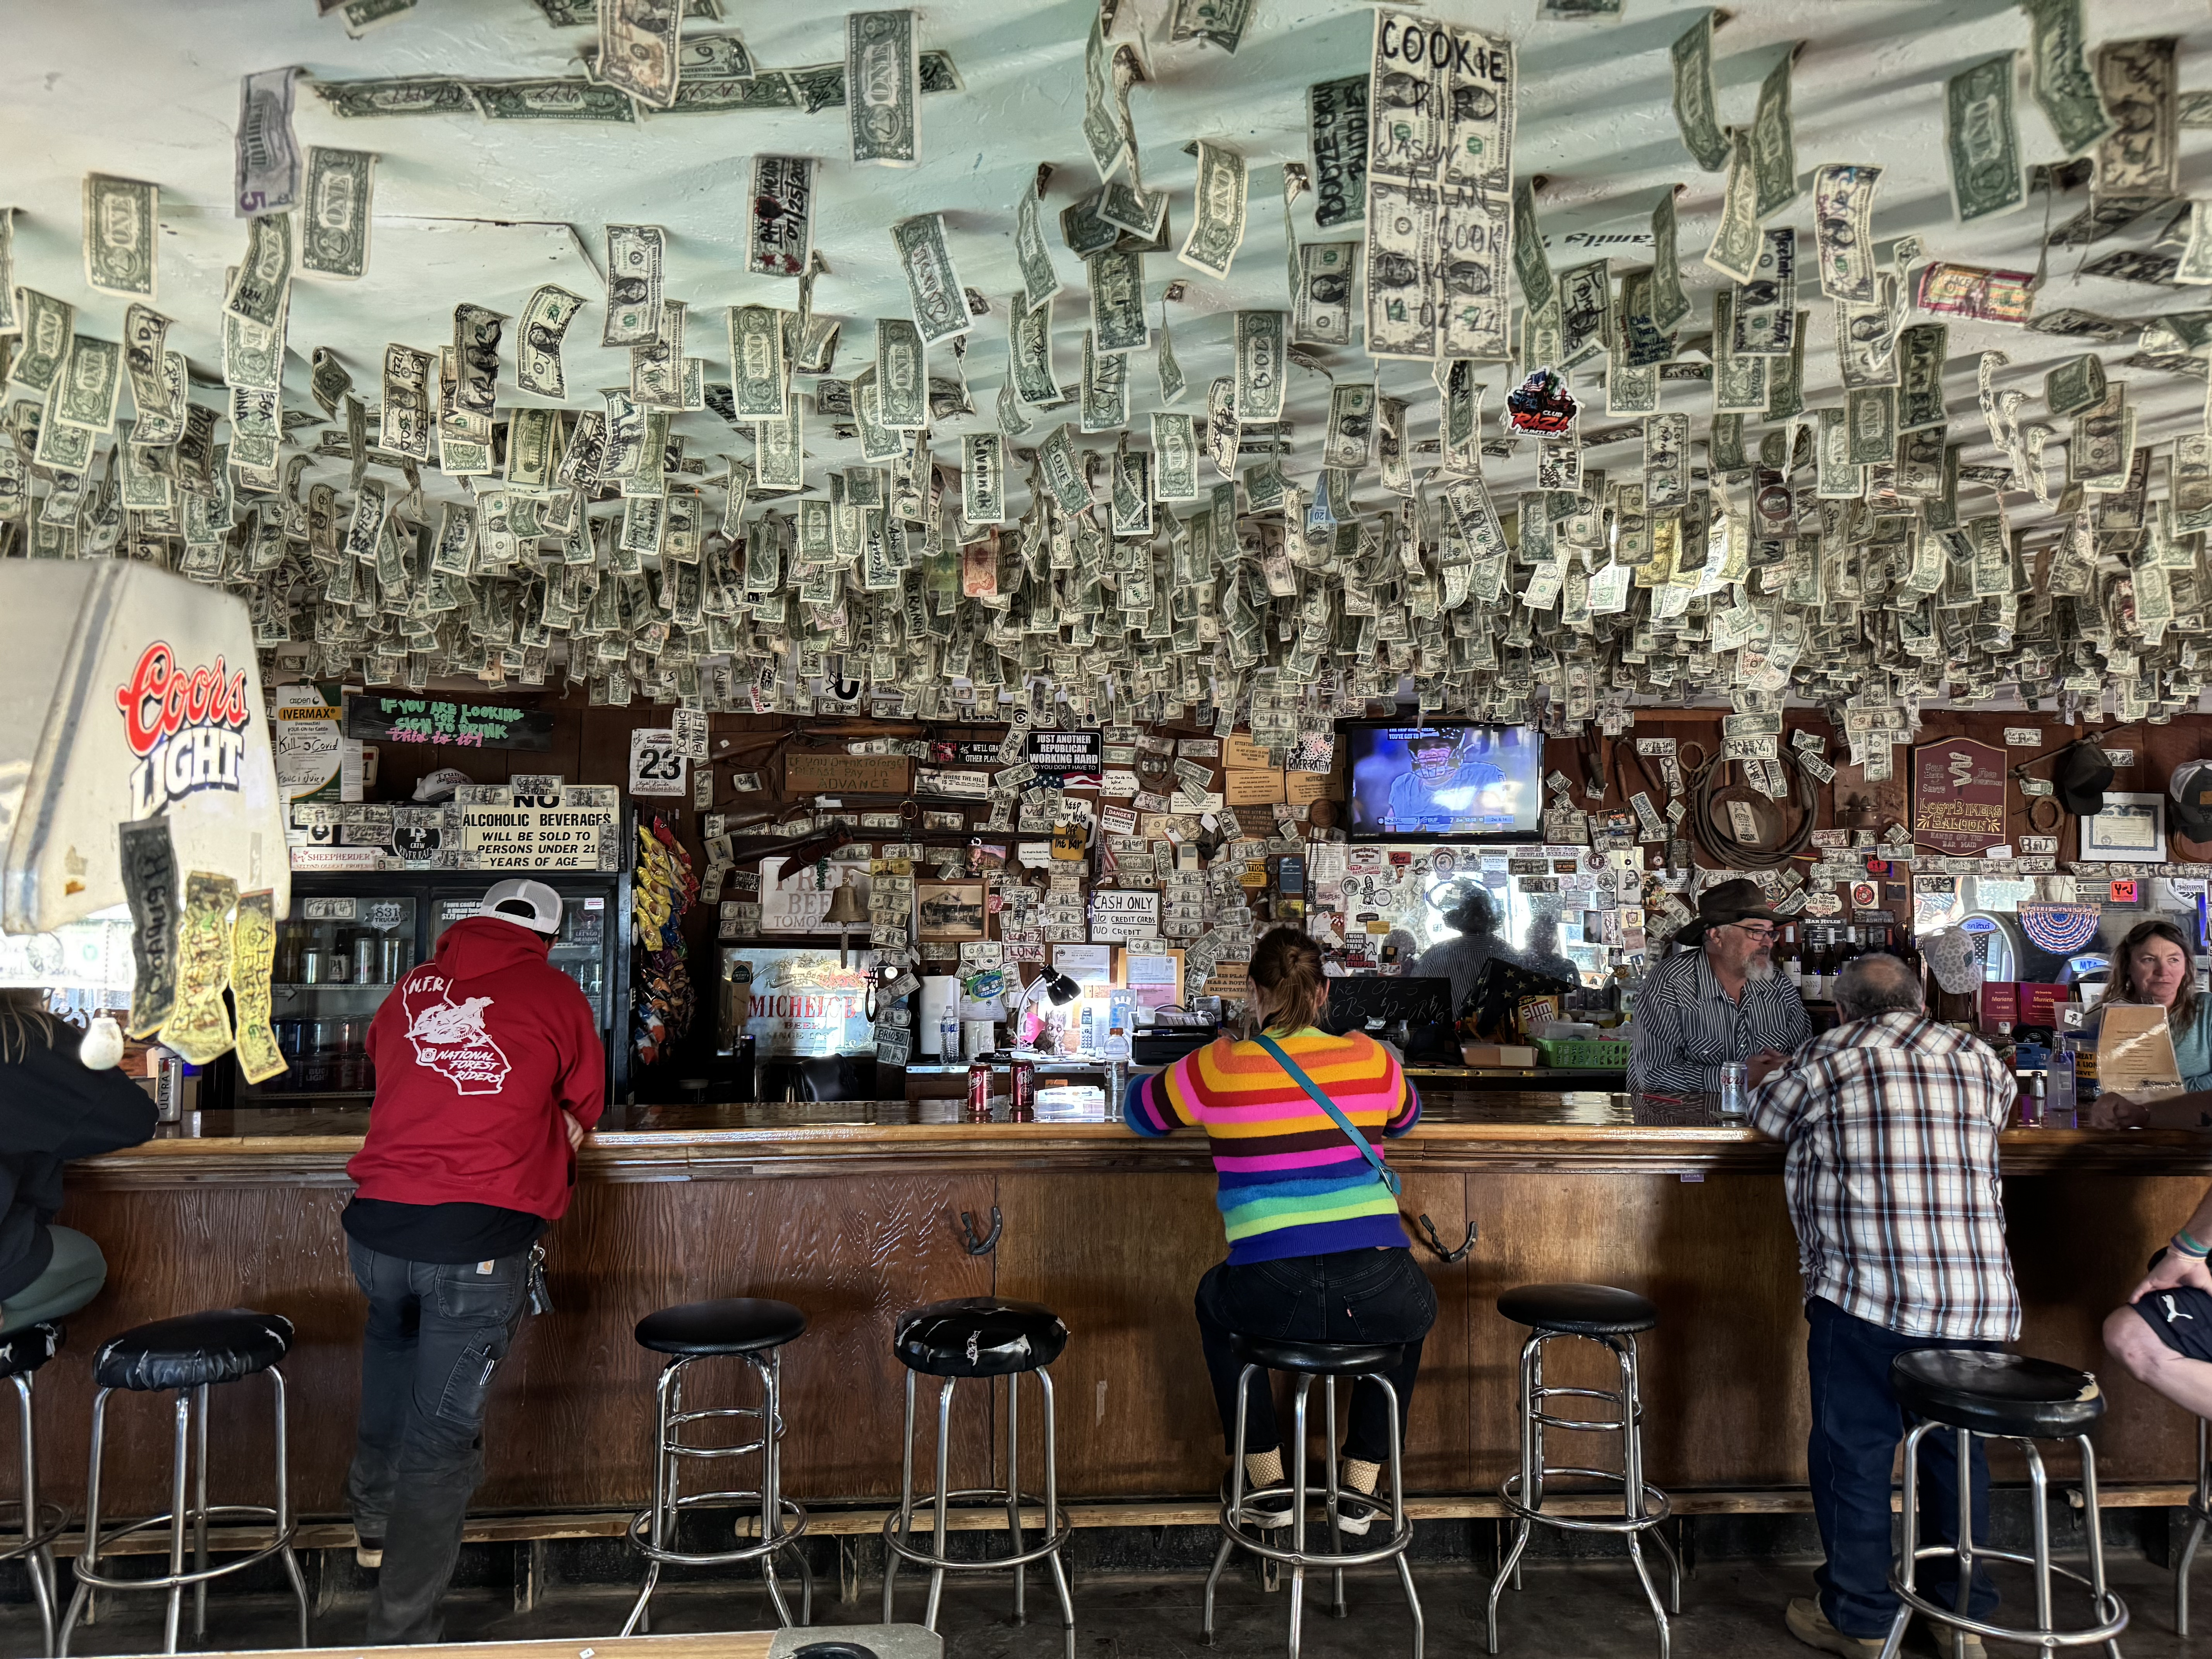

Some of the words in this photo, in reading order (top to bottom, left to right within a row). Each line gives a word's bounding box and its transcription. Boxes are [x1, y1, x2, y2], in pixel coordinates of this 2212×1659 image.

[1381, 20, 1507, 83] COOKIE
[1378, 121, 1458, 164] JASON
[323, 172, 351, 228] ONE
[1438, 216, 1500, 254] COOK
[747, 333, 765, 378] ONE
[894, 348, 912, 387] ONE
[1510, 409, 1571, 431] RAZA
[1519, 427, 1558, 437] HUMILDE
[1045, 440, 1078, 496] BONER
[115, 640, 250, 757] Coors
[381, 698, 397, 714] IF
[397, 699, 426, 714] YOU
[430, 702, 457, 715] ARE
[462, 704, 524, 722] LOOKING
[434, 714, 456, 723] FOR
[460, 715, 470, 725] A
[395, 717, 433, 734] SIGN
[435, 722, 455, 733] TO
[458, 723, 509, 739] DRINK
[312, 738, 338, 751] Covid
[1037, 735, 1056, 744] JUST
[1056, 735, 1091, 744] ANOTHER
[1041, 744, 1087, 753] REPUBLICAN
[639, 749, 681, 780] 23
[787, 757, 800, 766] IF
[805, 758, 827, 766] YOU
[1029, 754, 1073, 763] WORKING
[1073, 754, 1098, 764] HARD
[130, 726, 245, 821] LIGHT
[817, 779, 889, 789] ADVANCE
[514, 795, 560, 808] NO
[463, 813, 529, 826] ALCOHOLIC
[539, 813, 611, 826] BEVERAGES
[1108, 809, 1133, 819] DANGER
[1111, 818, 1133, 826] SMOKING
[483, 832, 512, 841] WILL
[518, 832, 534, 841] BE
[539, 832, 571, 841] SOLD
[575, 831, 591, 841] TO
[1930, 832, 1953, 840] HANDS
[477, 845, 537, 854] PERSONS
[538, 845, 578, 854] UNDER
[583, 844, 596, 853] 21
[489, 857, 529, 867] YEARS
[534, 857, 550, 866] OF
[555, 857, 579, 866] AGE
[2114, 884, 2133, 895] Y-J
[1094, 895, 1122, 909] CASH
[1127, 896, 1152, 909] ONLY
[375, 907, 398, 917] 831
[1092, 913, 1106, 922] NO
[1093, 926, 1108, 934] NO
[1372, 981, 1401, 995] OF
[1406, 980, 1427, 995] 5
[877, 1030, 904, 1043] BRIOSO
[434, 1048, 495, 1061] NATIONAL
[448, 1060, 501, 1070] FOREST
[453, 1068, 500, 1082] RIDERS
[160, 1075, 170, 1110] ULTRA
